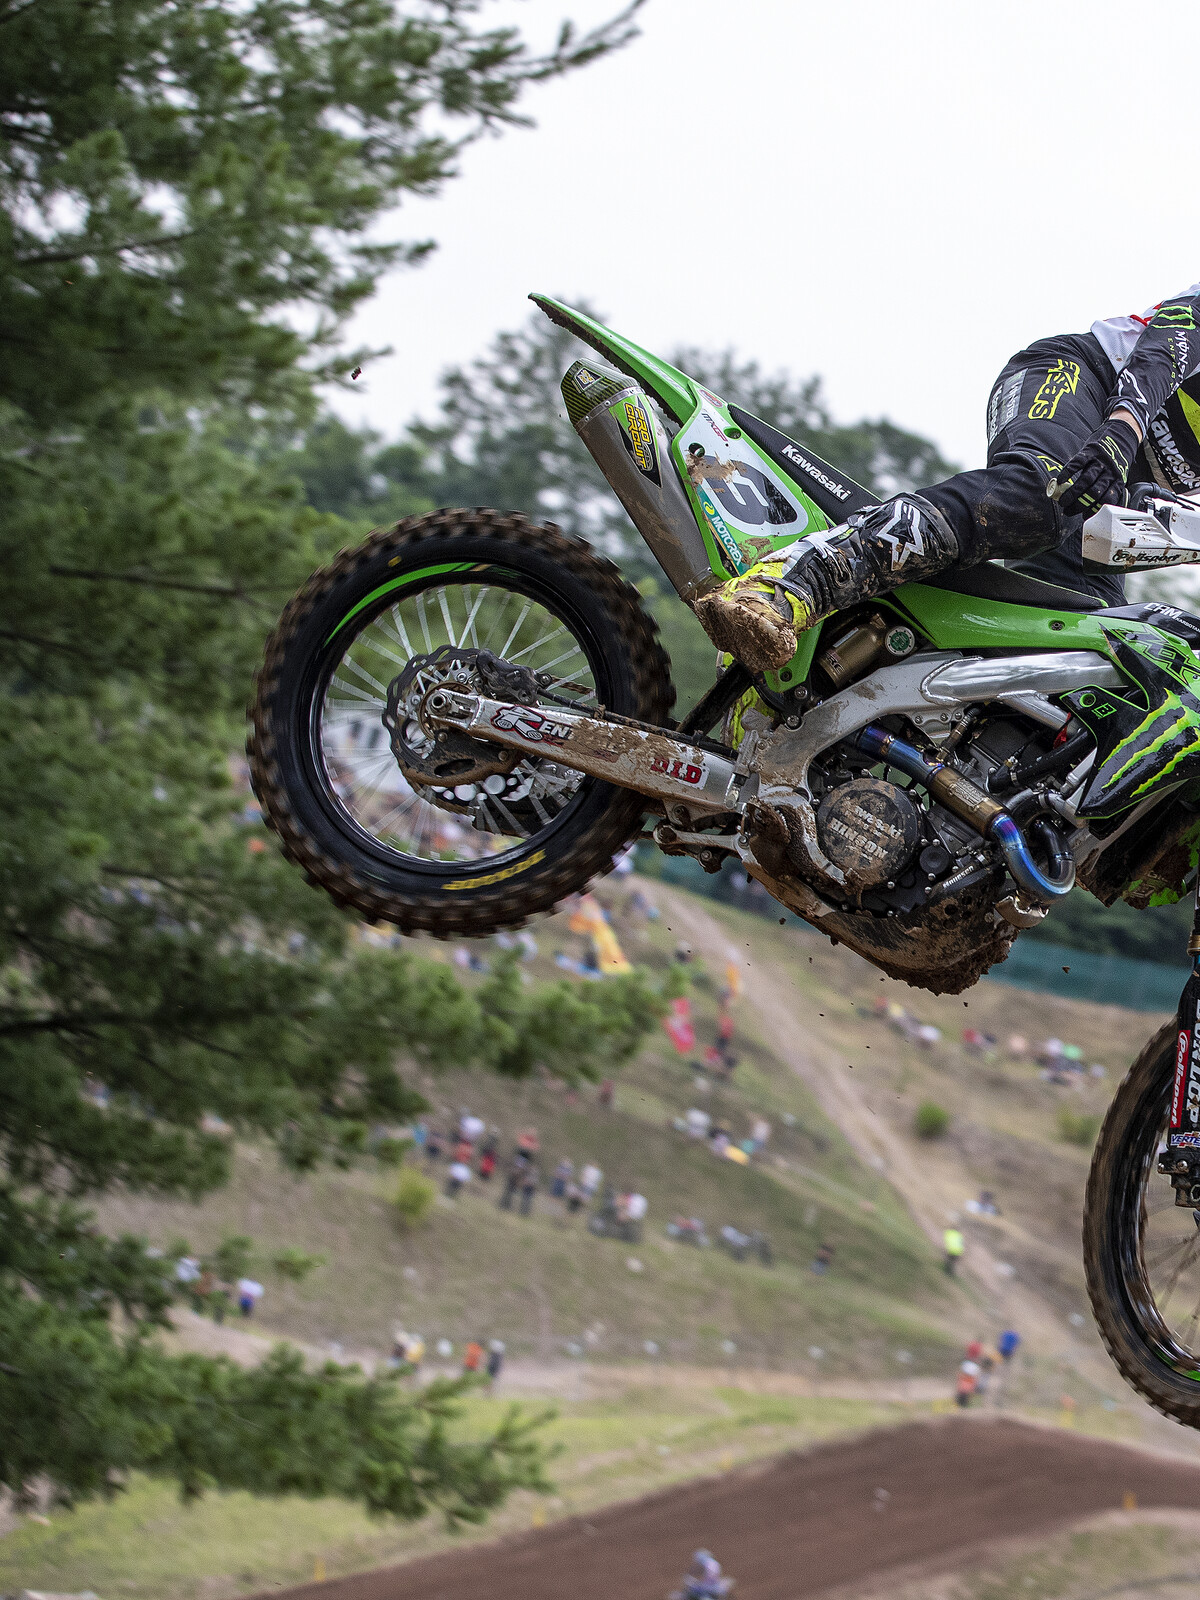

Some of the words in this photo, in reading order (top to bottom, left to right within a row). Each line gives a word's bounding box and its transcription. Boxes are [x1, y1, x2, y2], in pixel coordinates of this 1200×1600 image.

[625, 402, 647, 469] CIRCUIT
[635, 408, 651, 443] PRO
[781, 444, 852, 501] Kawasaki
[711, 515, 743, 567] MOTOREX
[1170, 1031, 1188, 1126] Polisport
